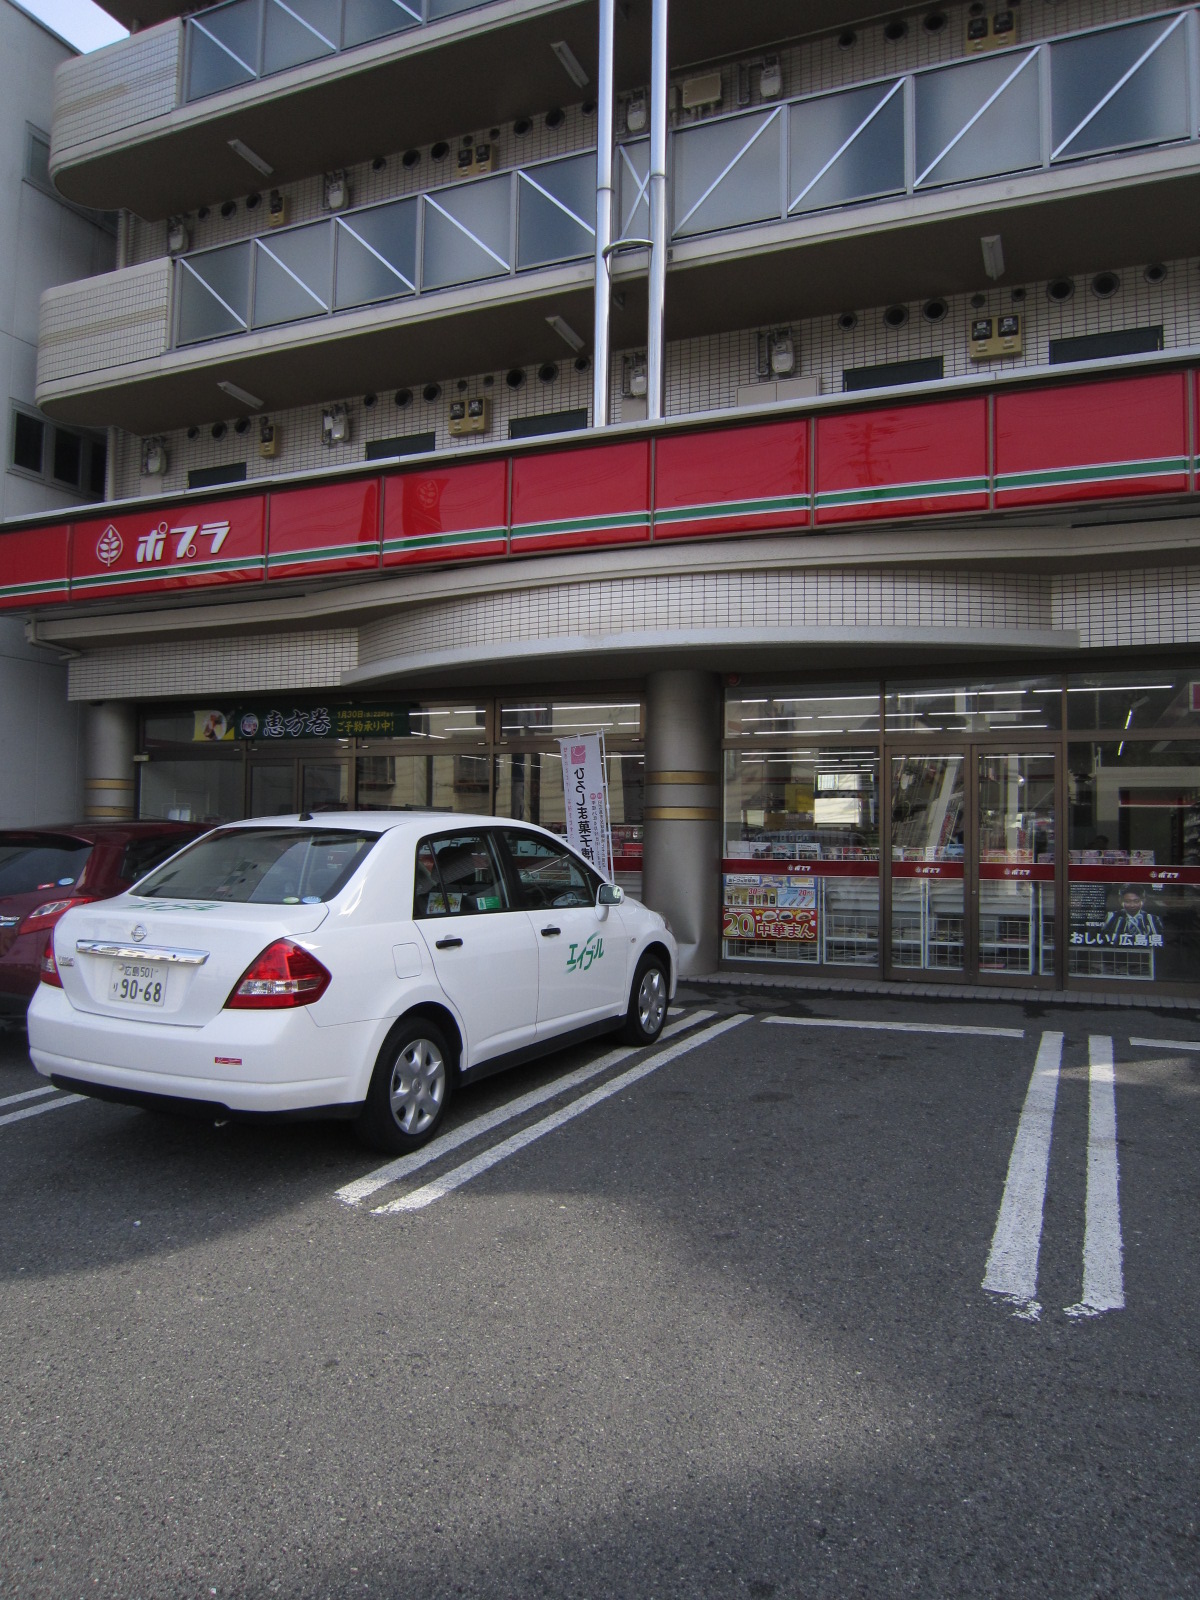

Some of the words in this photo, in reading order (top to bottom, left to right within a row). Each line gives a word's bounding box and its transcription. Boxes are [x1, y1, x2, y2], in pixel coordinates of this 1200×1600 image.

[136, 521, 231, 563] ポプラ
[263, 708, 331, 737] 恵方巻
[723, 913, 755, 937] 20
[757, 922, 815, 938] 中華まん
[1069, 931, 1164, 947] おしい!広島県
[566, 936, 604, 971] エイブル
[120, 978, 162, 1003] 90-68
